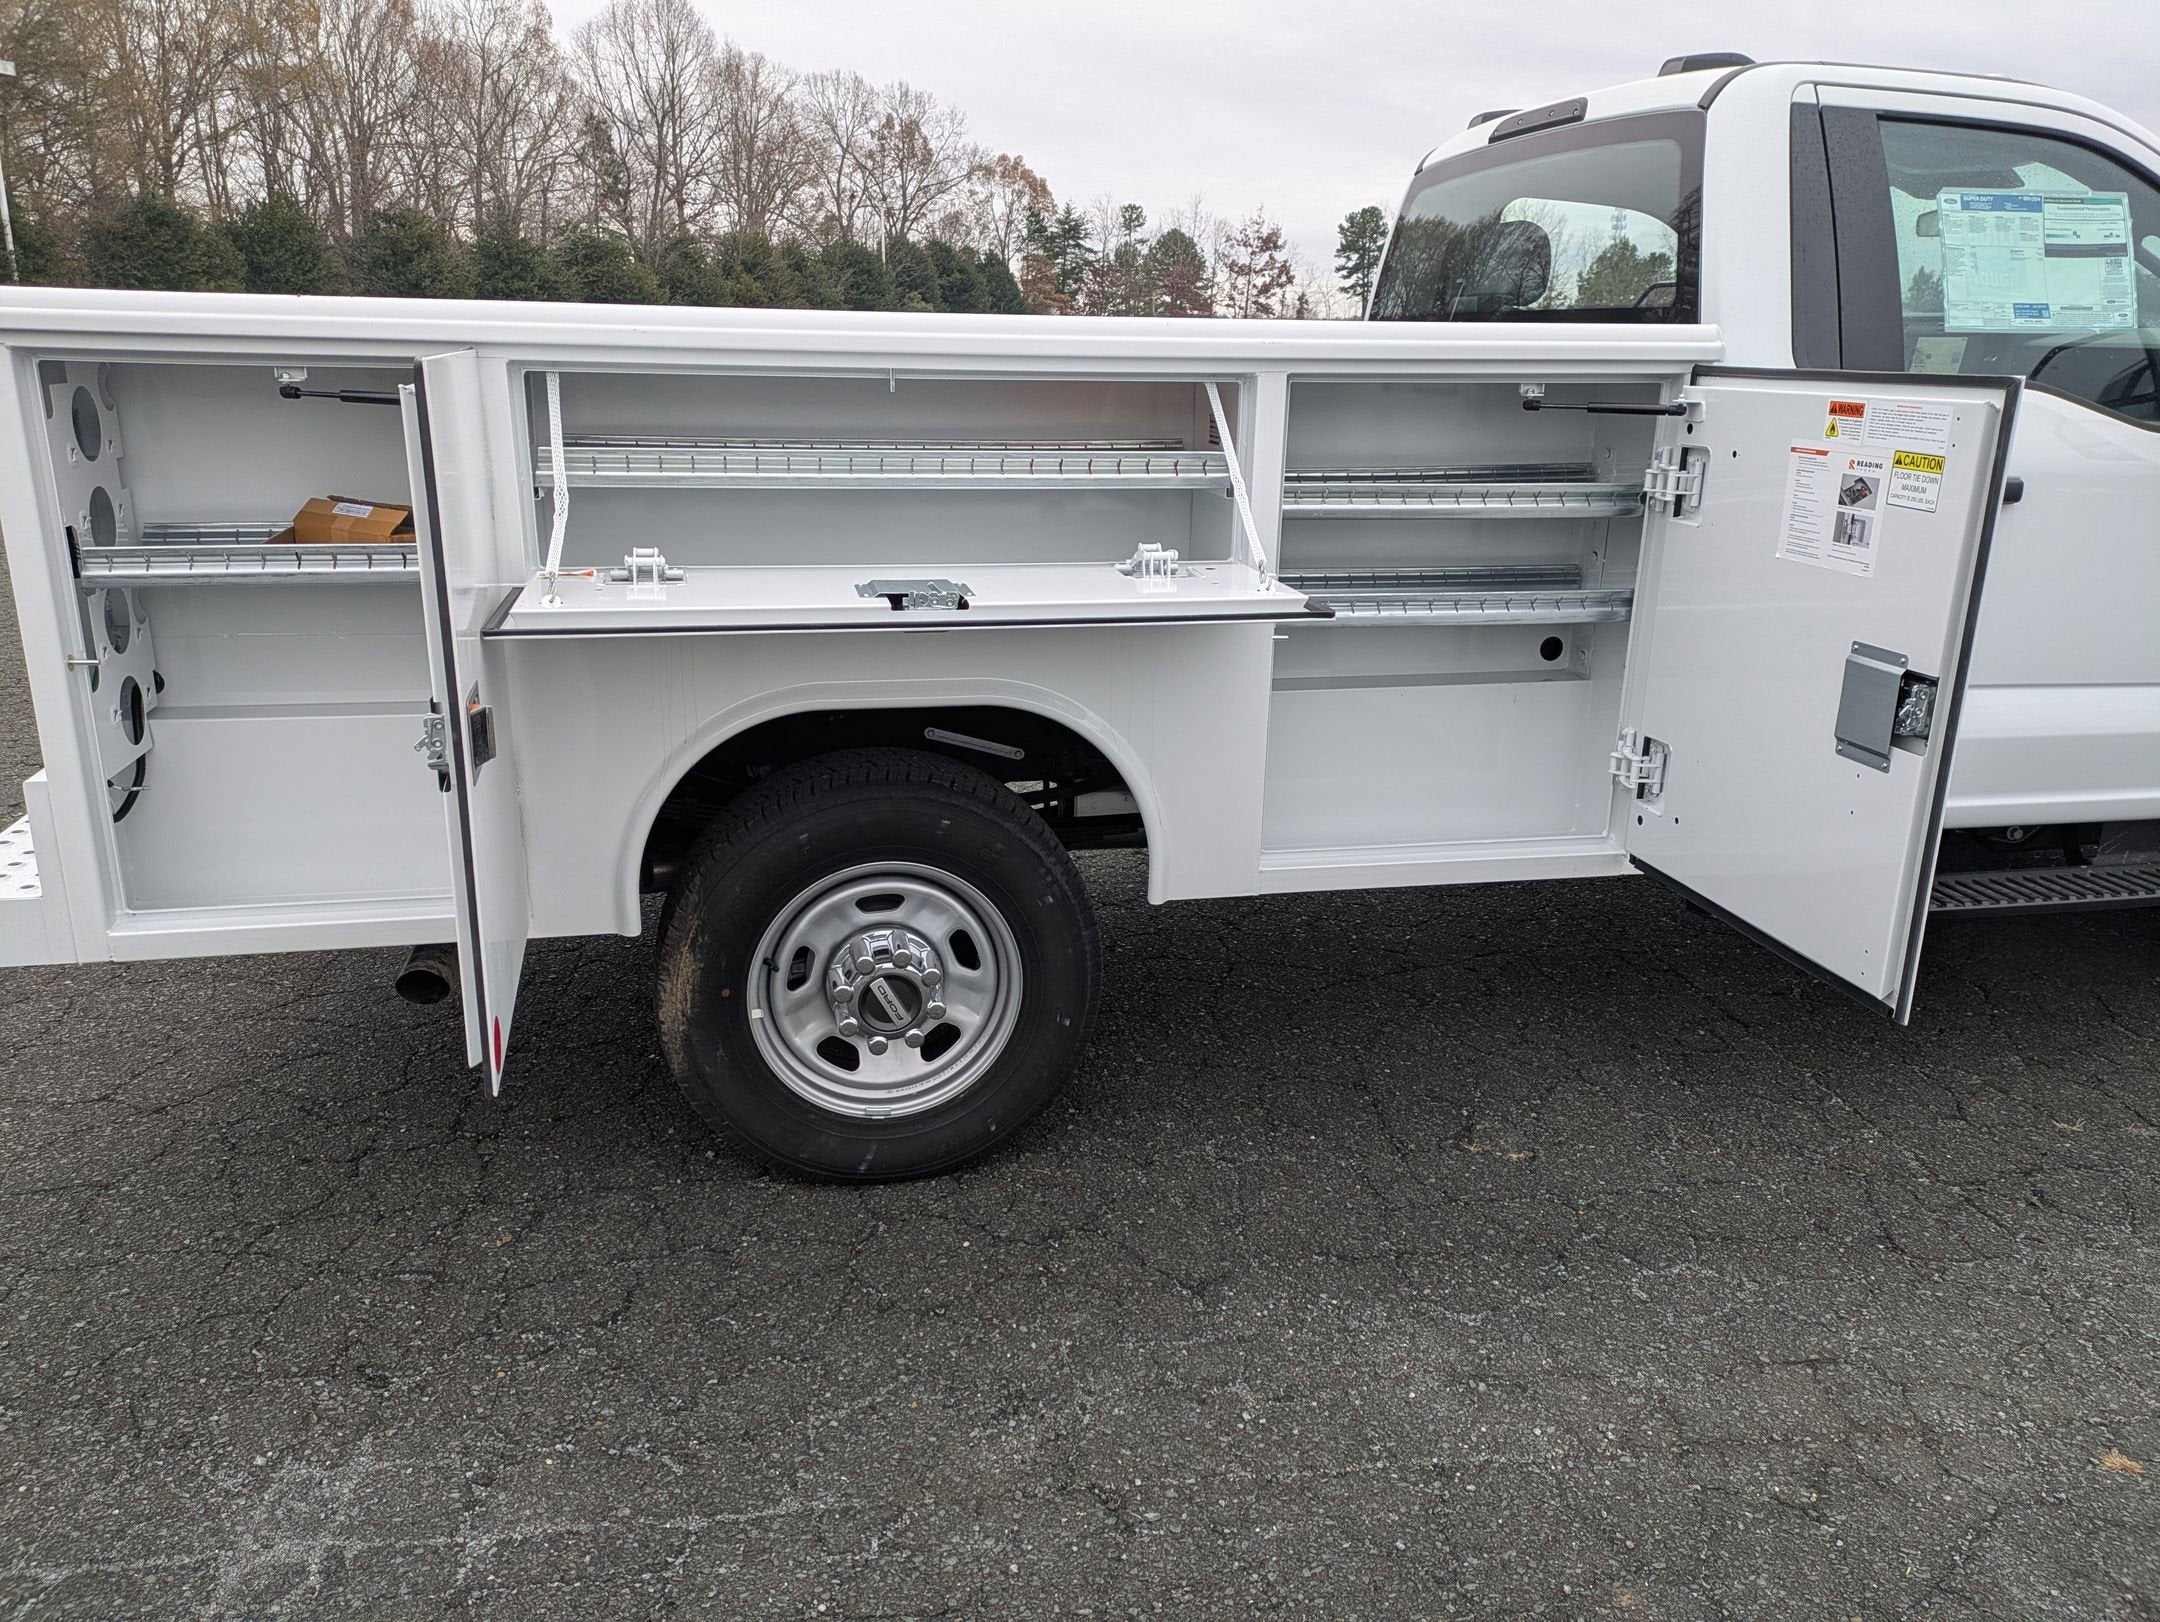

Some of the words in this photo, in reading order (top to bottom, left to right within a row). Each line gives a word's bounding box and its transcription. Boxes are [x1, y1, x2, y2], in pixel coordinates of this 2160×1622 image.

[1838, 403, 1864, 416] WARNING
[1857, 460, 1883, 470] READING
[1903, 454, 1943, 471] CAUTION
[1894, 471, 1912, 481] FLOOR
[1912, 473, 1921, 483] TIE
[1921, 475, 1939, 485] DOWN
[1901, 483, 1927, 494] MAXIMUM
[877, 985, 904, 1021] FORD
